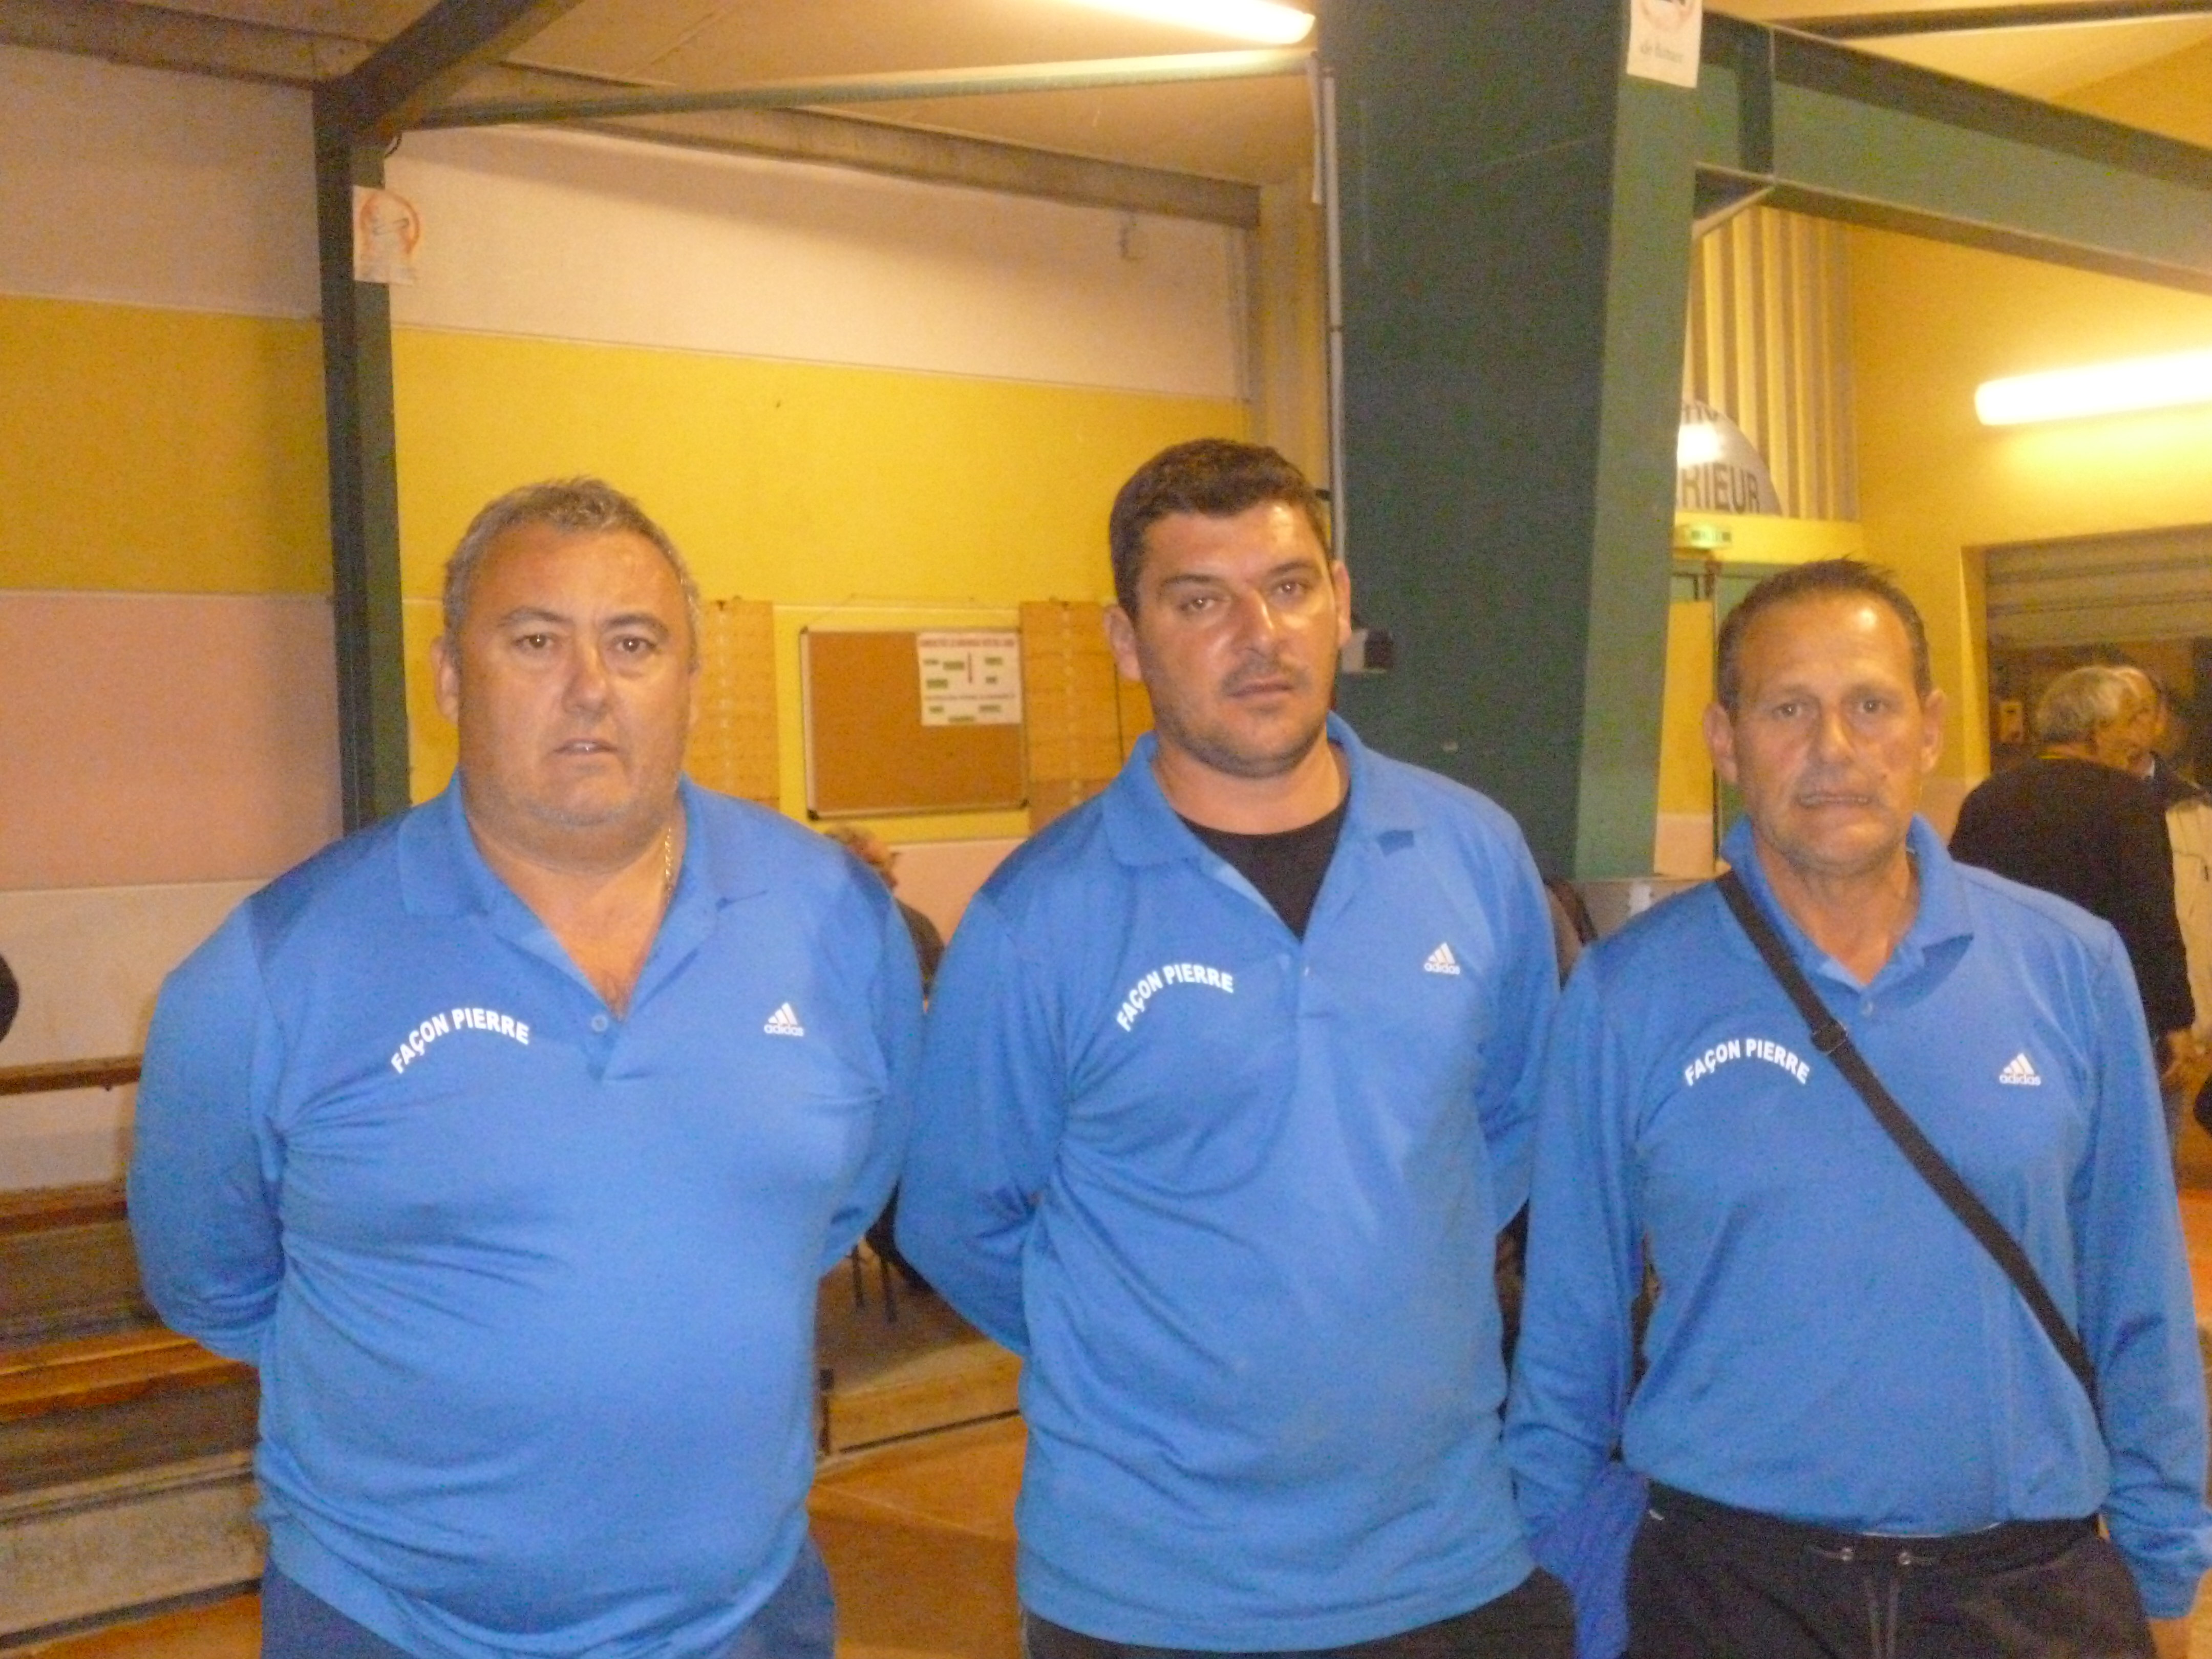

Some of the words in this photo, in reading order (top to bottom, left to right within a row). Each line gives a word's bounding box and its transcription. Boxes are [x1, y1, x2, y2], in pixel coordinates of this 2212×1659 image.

[1423, 960, 1460, 975] adidas
[1117, 971, 1163, 1032] FAÇON
[1162, 963, 1234, 993] PIERRE
[391, 1013, 450, 1074] FAÇON
[451, 1007, 529, 1045] PIERRE
[763, 1023, 804, 1037] adidas
[1685, 1039, 1741, 1086] FAÇON
[1746, 1038, 1810, 1084] PIERRE
[1998, 1073, 2041, 1086] adidas
